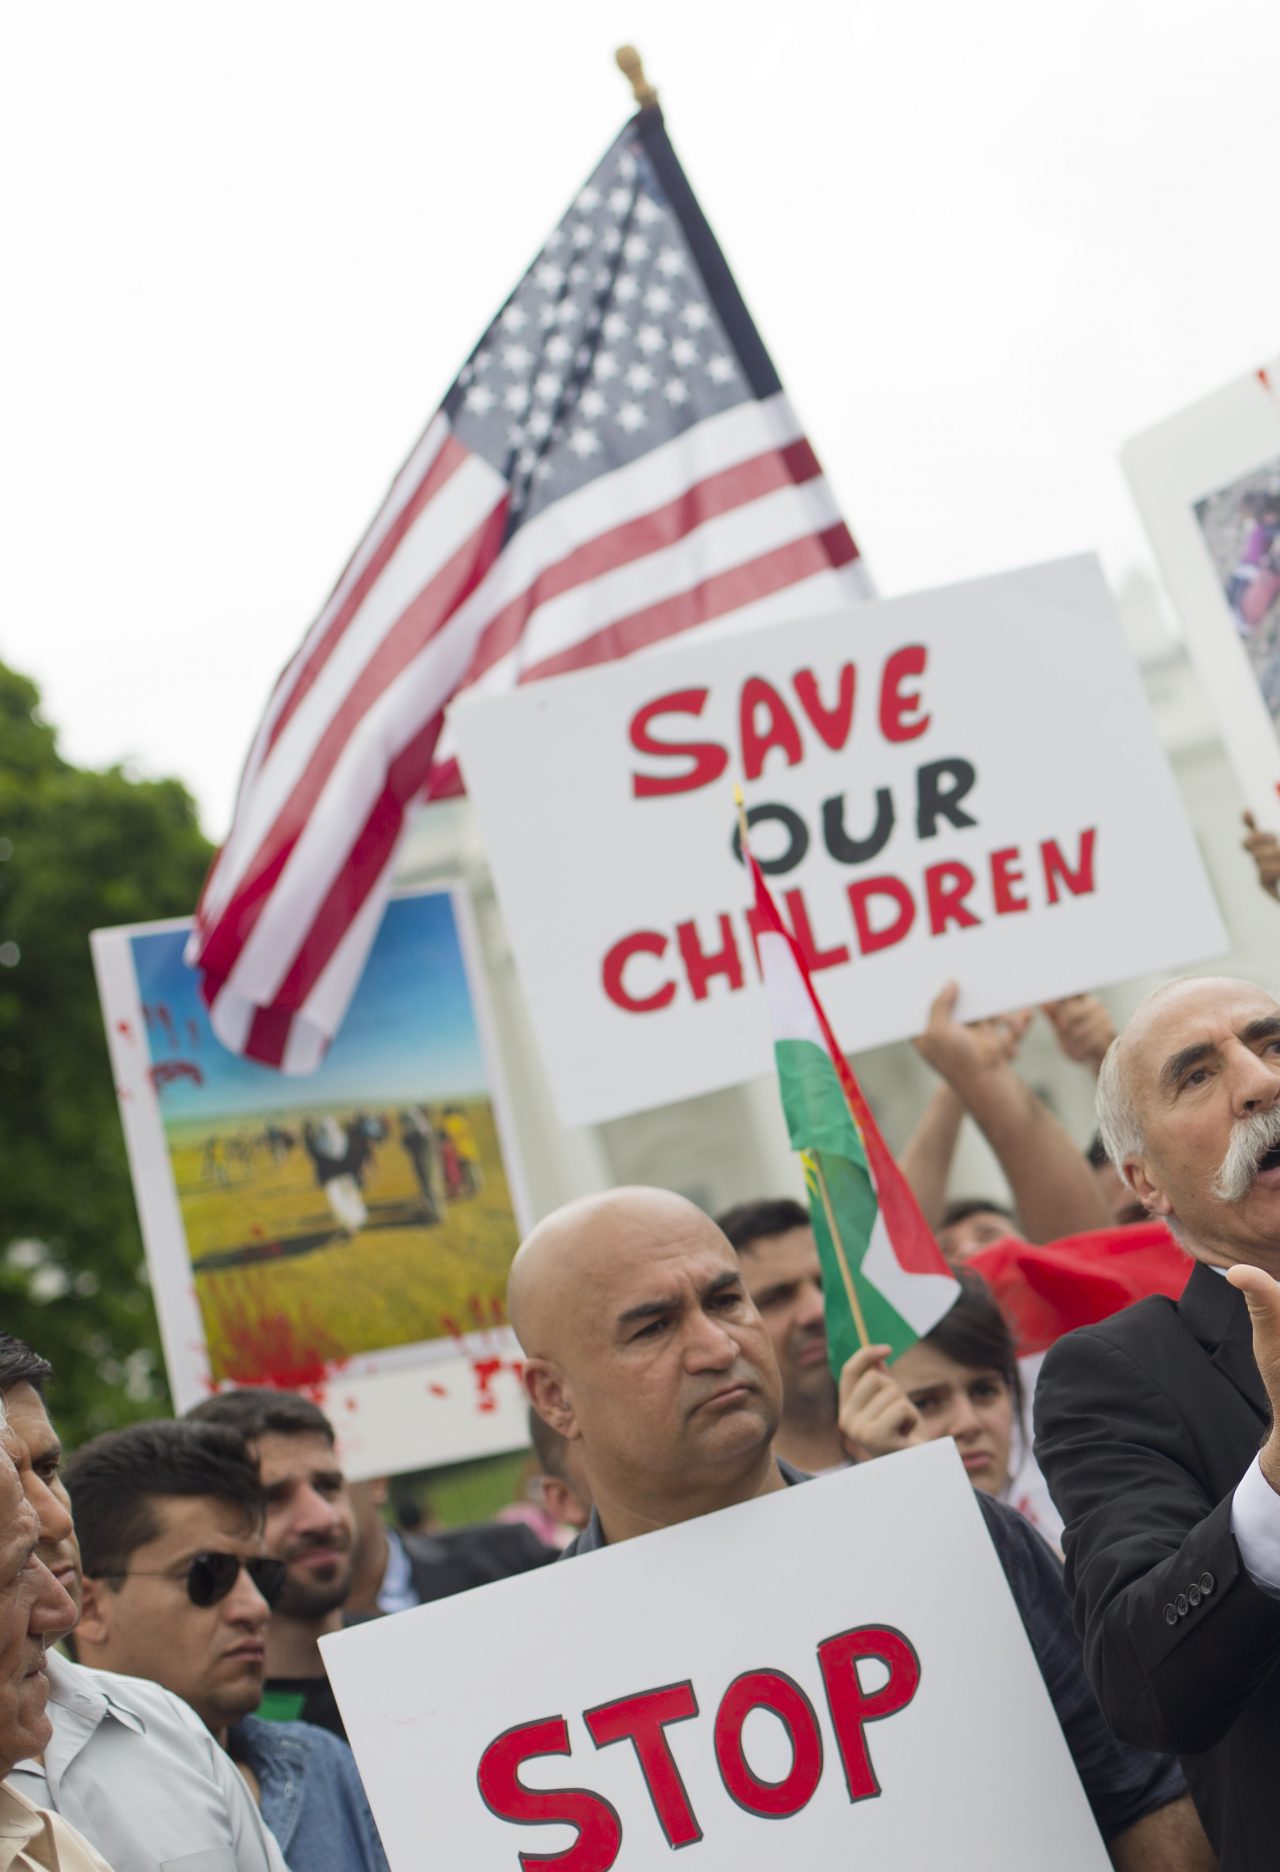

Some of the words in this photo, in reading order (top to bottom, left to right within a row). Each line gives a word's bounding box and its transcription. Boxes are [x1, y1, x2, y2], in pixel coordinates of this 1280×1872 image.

[628, 643, 932, 800] SAVE
[731, 757, 979, 876] OUR
[601, 826, 1098, 1015] CHILDREN
[476, 1623, 921, 1872] STOP
